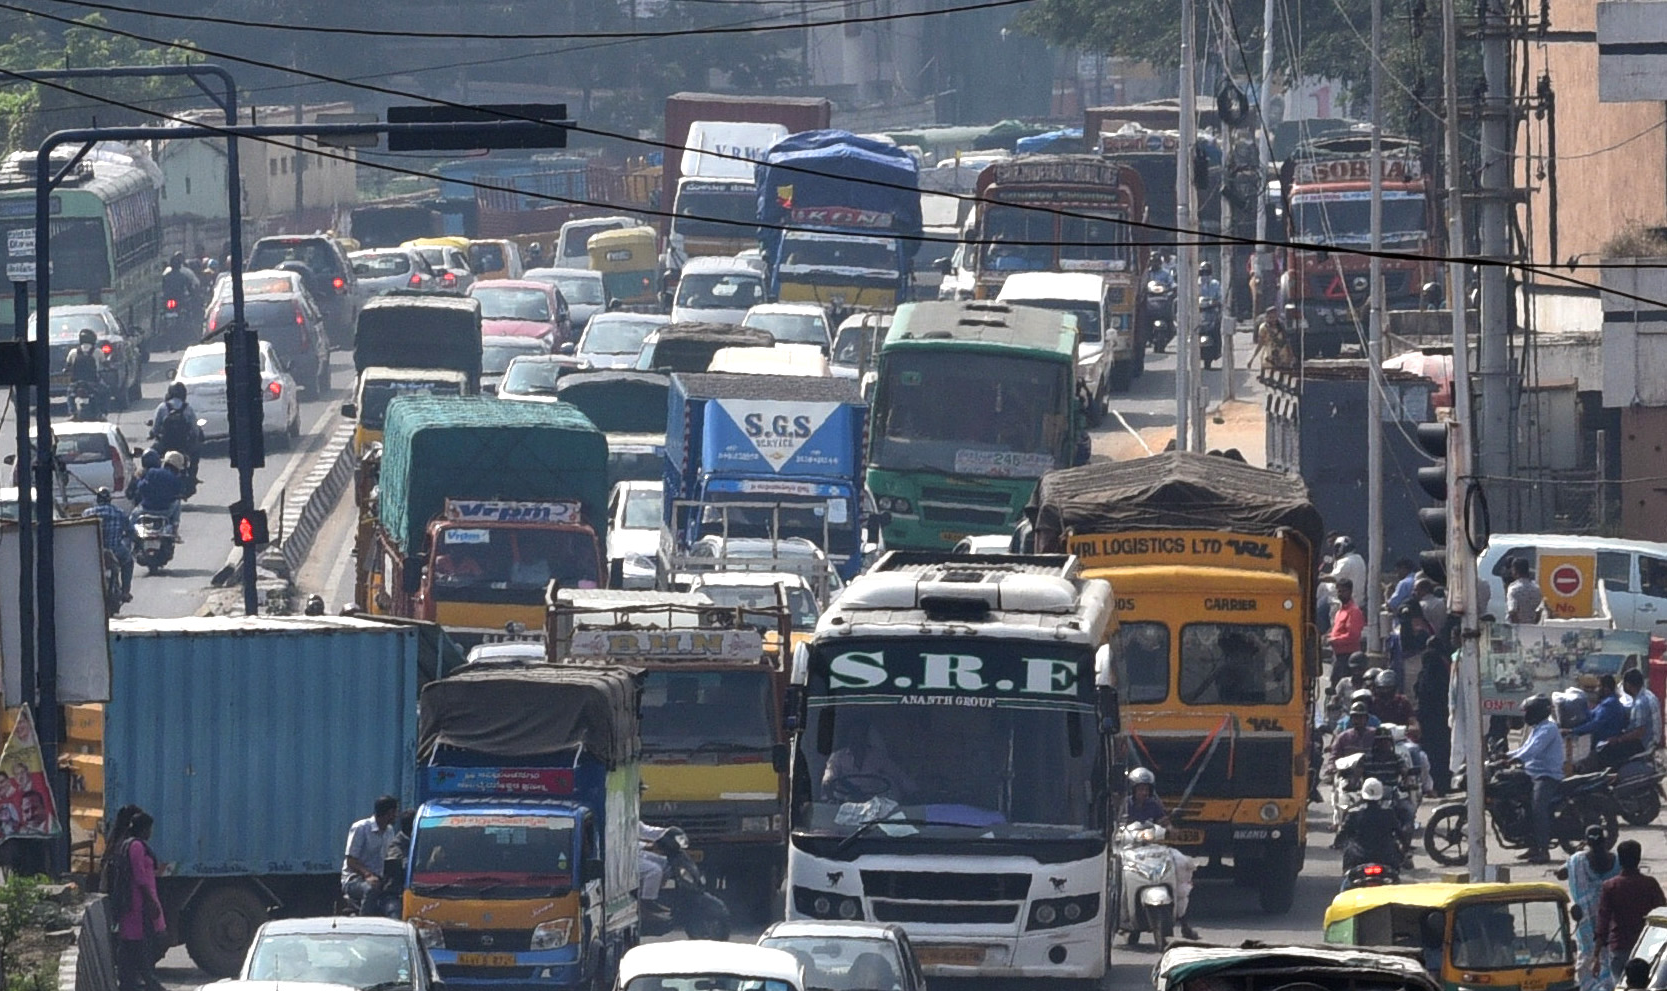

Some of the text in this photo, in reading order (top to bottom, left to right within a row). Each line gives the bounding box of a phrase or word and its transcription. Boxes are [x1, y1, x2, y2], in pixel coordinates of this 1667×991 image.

[1312, 161, 1403, 181] SOBA
[744, 413, 812, 438] S.G.S
[1103, 537, 1184, 556] LOGISTICS
[1192, 538, 1222, 556] LTD
[1203, 598, 1257, 611] CARRIER
[1555, 603, 1576, 613] No
[829, 651, 1079, 696] S.R.E
[900, 695, 996, 708] ANANTH GROUP
